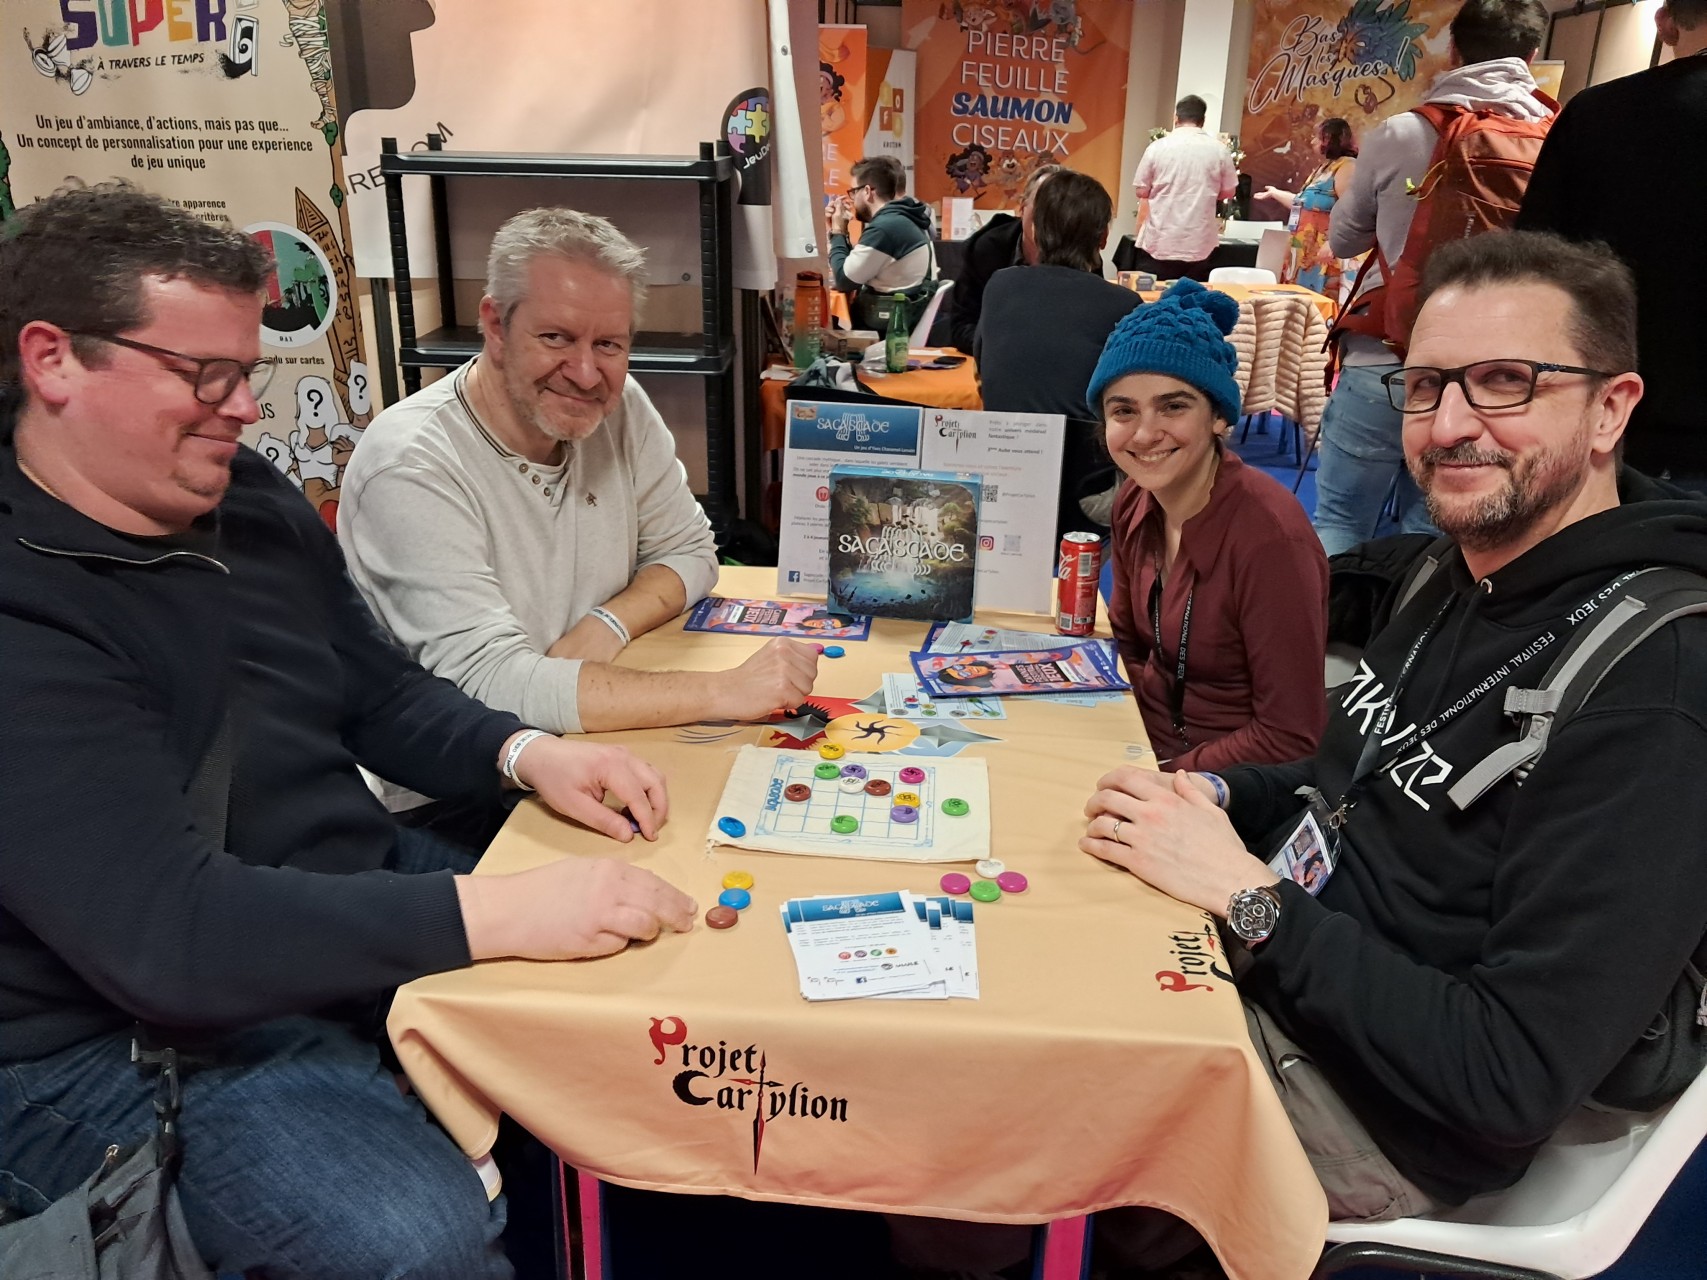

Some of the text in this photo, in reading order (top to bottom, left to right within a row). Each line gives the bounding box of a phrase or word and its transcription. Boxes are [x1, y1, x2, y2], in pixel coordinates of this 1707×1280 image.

[60, 0, 227, 50] SUPER
[1280, 14, 1342, 56] Bas
[97, 53, 204, 70] À TRAVERS LE TEMPS
[968, 30, 1067, 63] PIERRE
[1315, 50, 1333, 70] les
[961, 60, 1070, 94] FEUILLE
[1248, 52, 1383, 114] Masques
[951, 91, 1073, 125] SAUMON
[36, 115, 289, 133] Un jeu d'ambiance, d'actions, mais pas que...
[952, 122, 1070, 155] CISEAUX
[17, 134, 313, 154] Un concept de personnalisation pour une experience
[131, 155, 206, 171] de jeu unique
[182, 200, 226, 211] apparence
[285, 357, 297, 365] sur
[300, 356, 325, 365] cartes
[935, 415, 959, 429] Projet
[1566, 599, 1599, 626] JEUX
[1509, 631, 1556, 668] FESTIVAL
[1038, 662, 1065, 682] JEUX
[1439, 664, 1511, 722] INTERNATIONAL
[1419, 719, 1438, 737] DES
[1155, 934, 1215, 992] Projet
[648, 1016, 758, 1078] Projet
